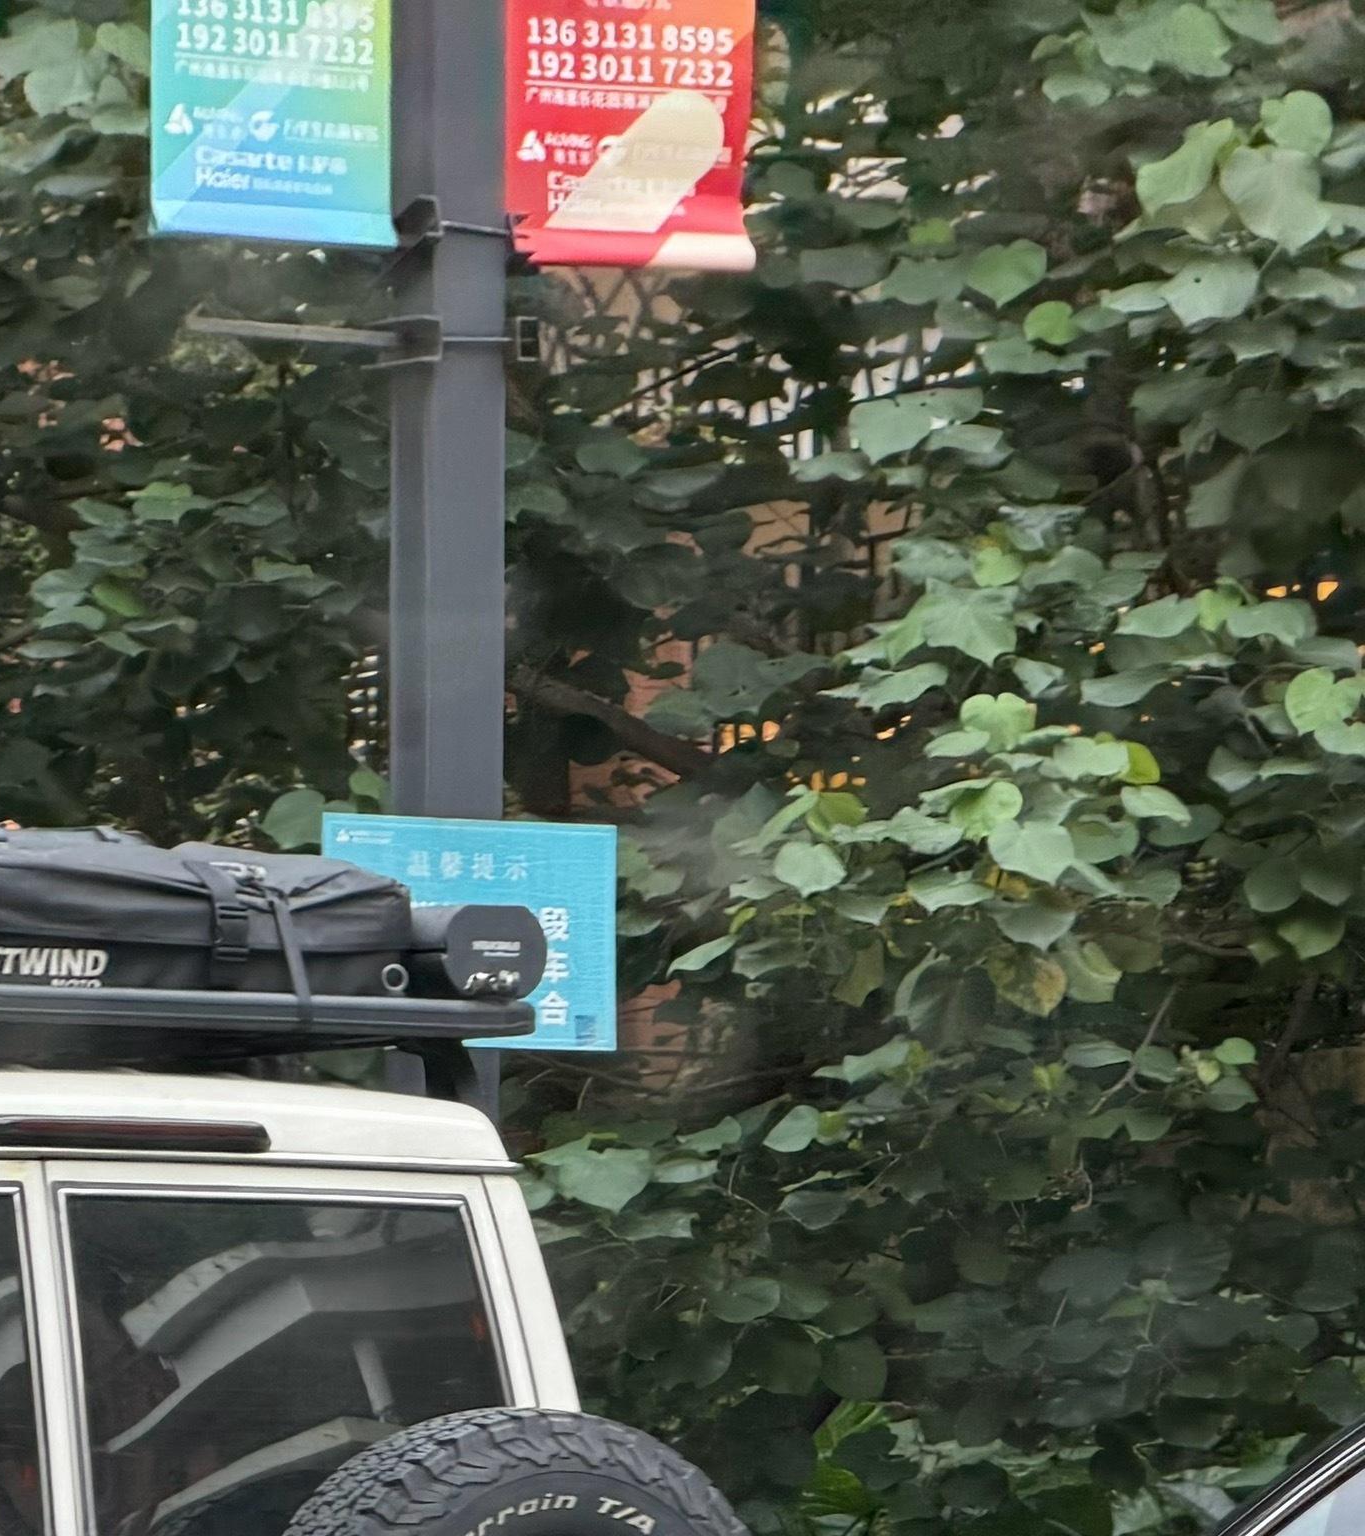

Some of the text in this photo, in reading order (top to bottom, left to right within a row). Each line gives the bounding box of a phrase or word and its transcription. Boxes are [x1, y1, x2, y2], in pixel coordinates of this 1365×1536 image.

[233, 0, 299, 25] 3131
[176, 22, 374, 65] 192 3011 7232
[527, 17, 734, 55] 136 3131 8595
[527, 50, 734, 87] 192 3011 7232
[538, 990, 570, 1025] 合
[596, 1496, 657, 1536] T/A
